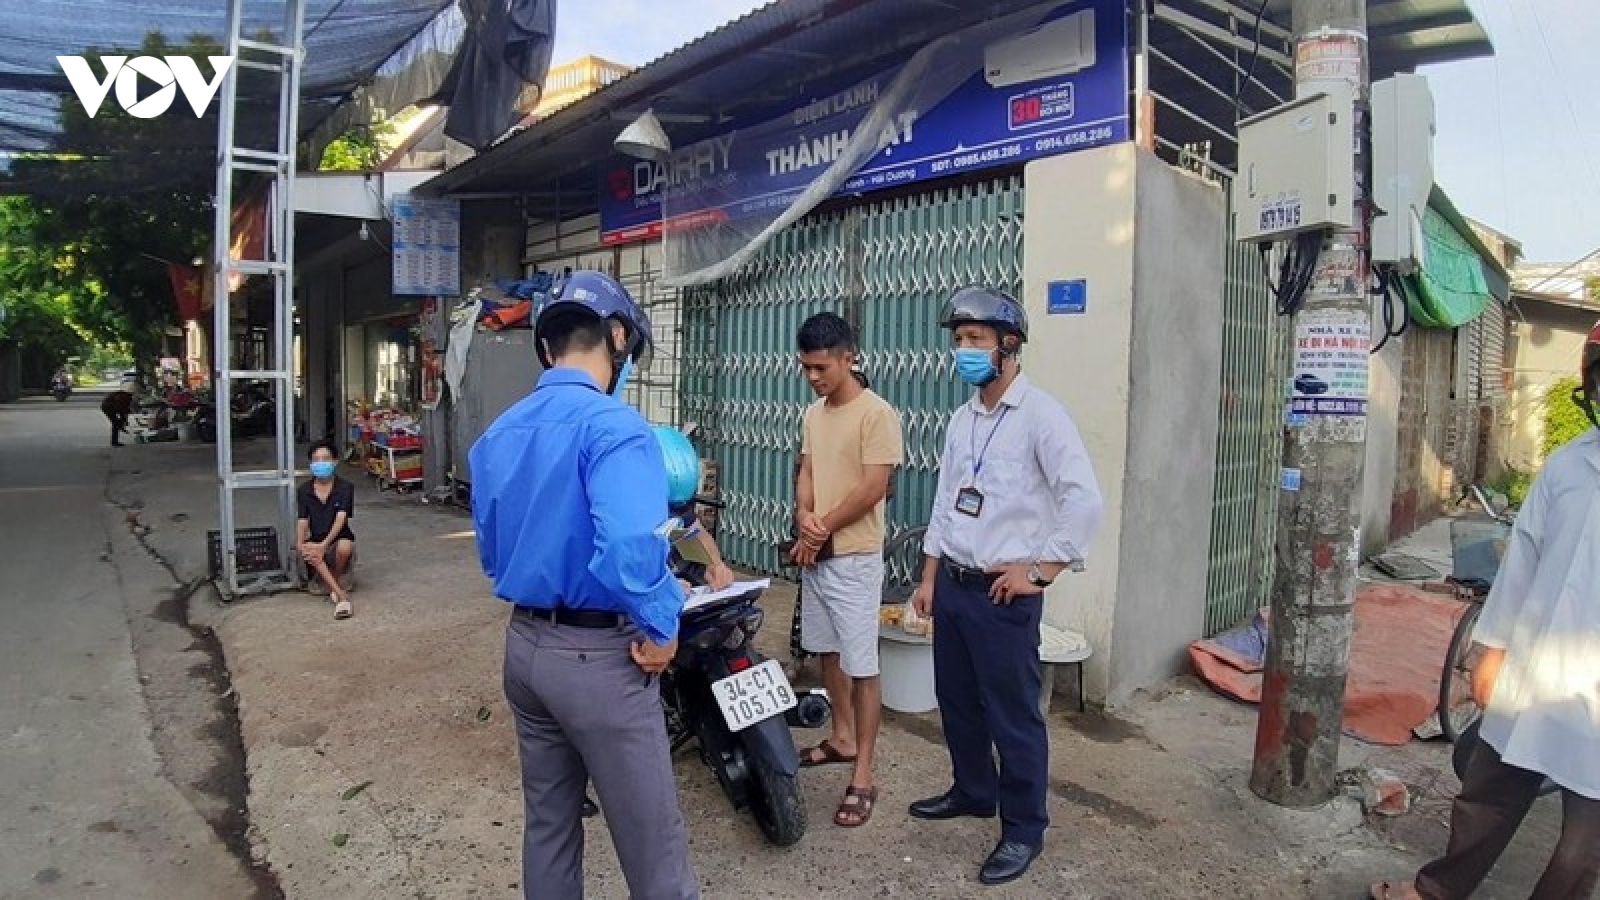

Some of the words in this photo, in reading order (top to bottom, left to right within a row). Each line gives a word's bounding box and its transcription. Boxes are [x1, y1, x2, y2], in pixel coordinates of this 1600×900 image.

[1013, 97, 1041, 125] 30
[766, 129, 849, 176] THÀNH
[873, 110, 918, 156] ẠT
[724, 667, 775, 701] 34-C1
